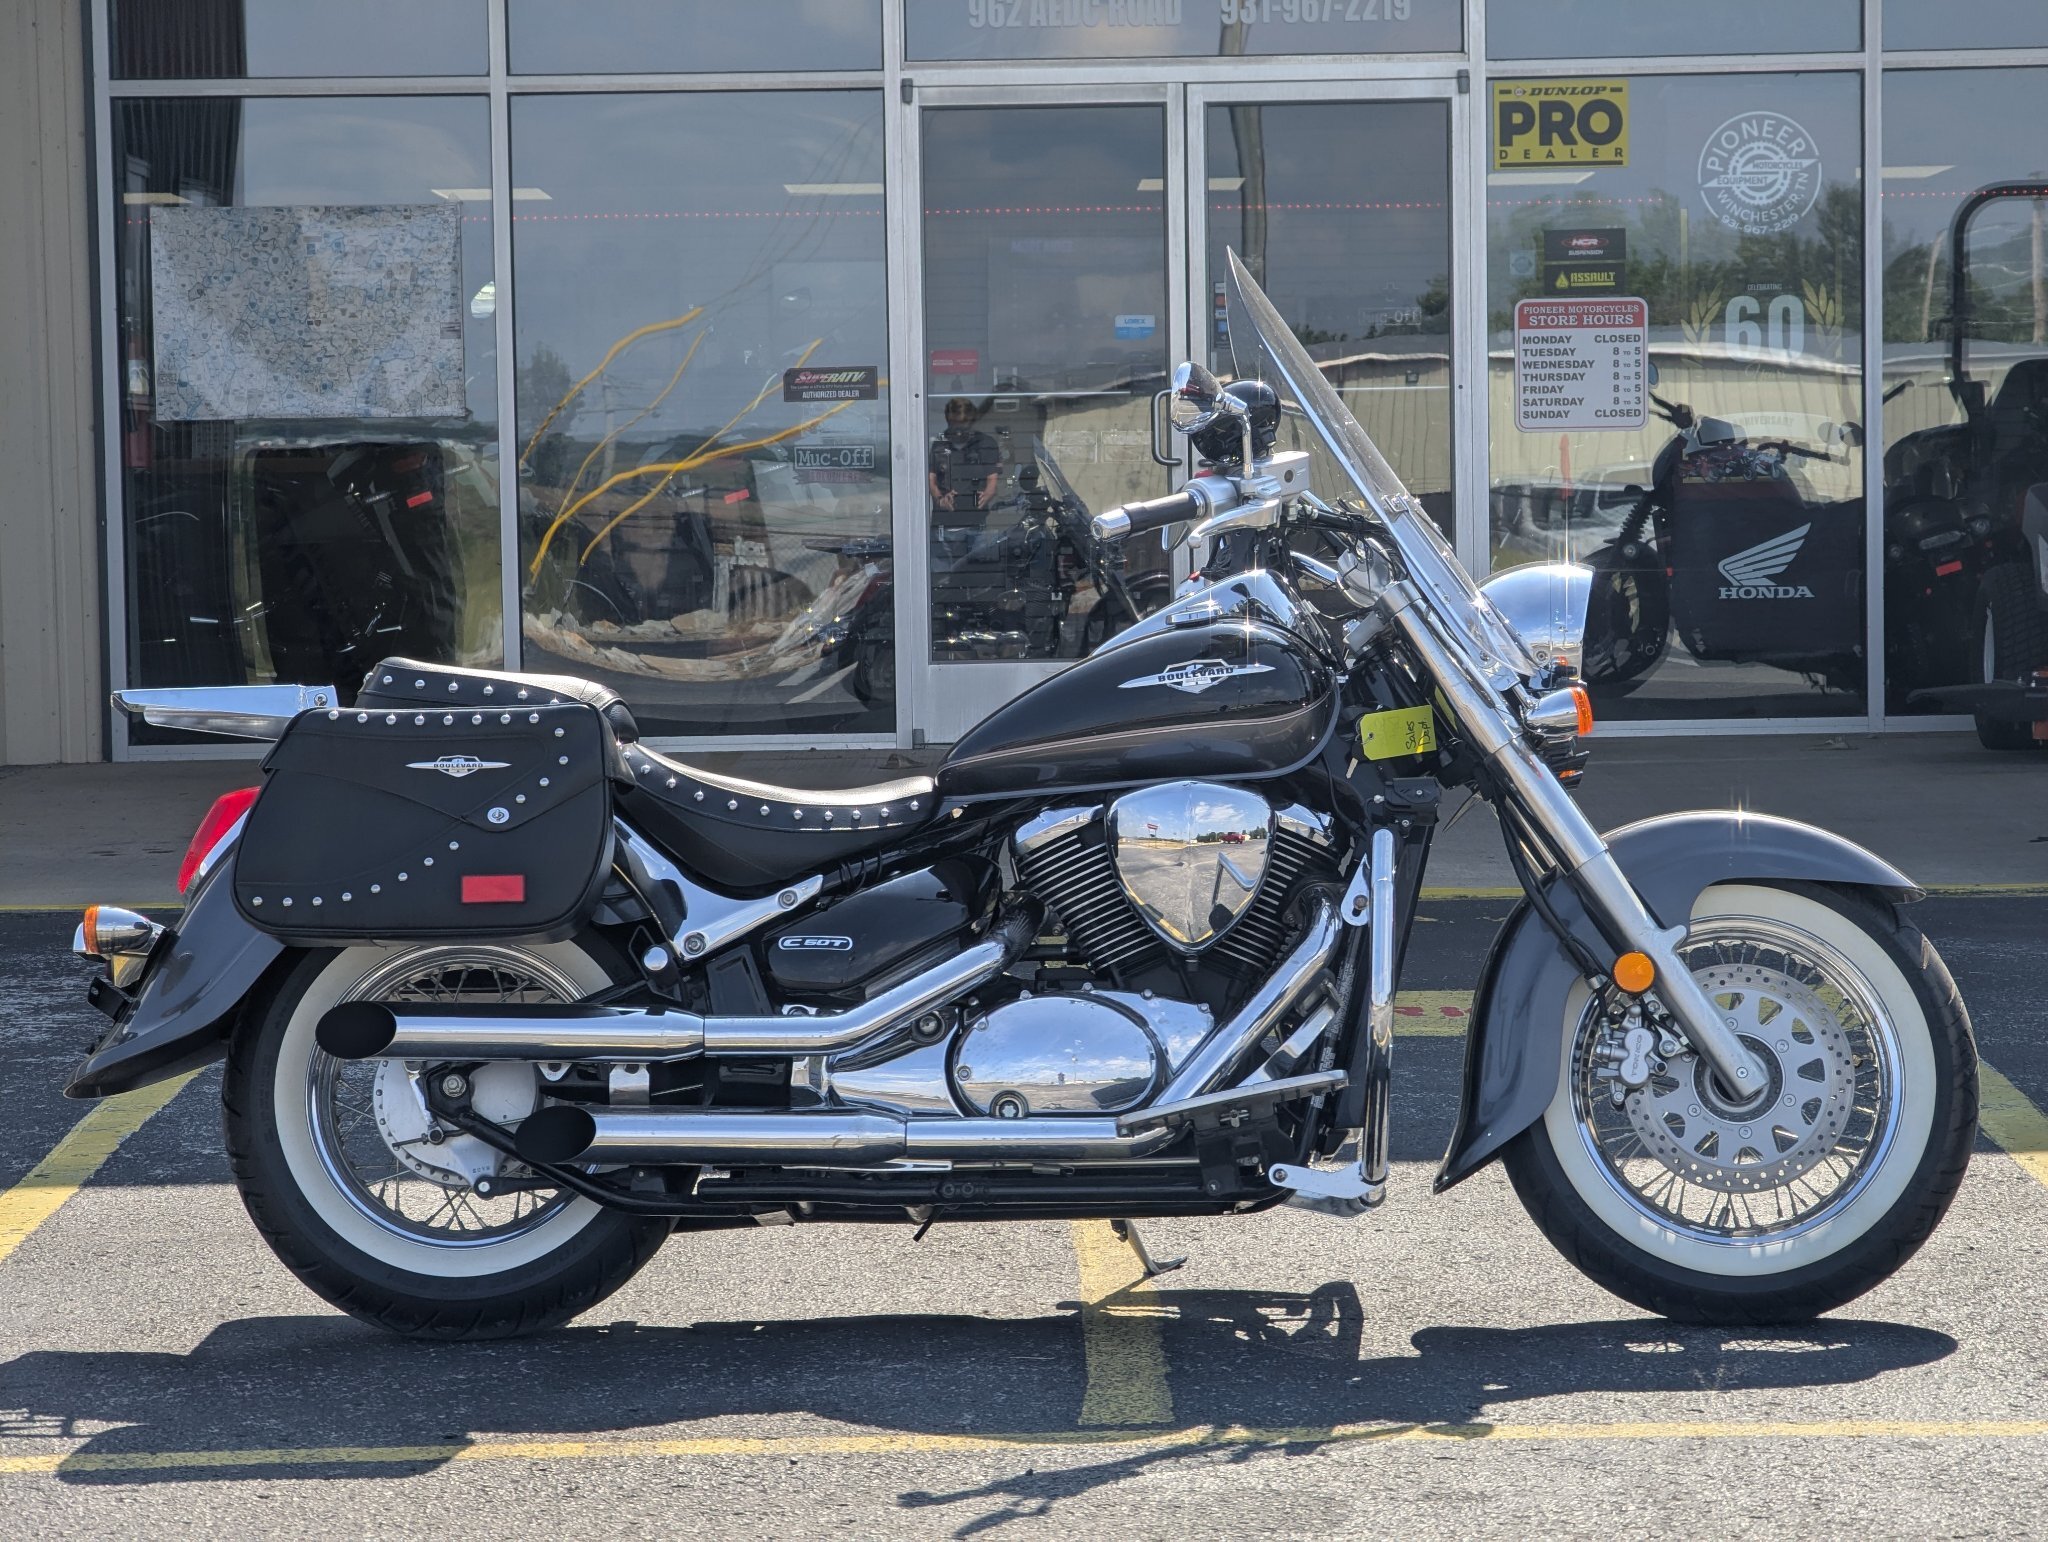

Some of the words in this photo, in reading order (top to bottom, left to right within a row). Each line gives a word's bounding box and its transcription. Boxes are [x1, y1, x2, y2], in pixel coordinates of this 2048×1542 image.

[968, 0, 1023, 28] 962
[1529, 86, 1607, 97] DUNLOP
[1499, 98, 1624, 147] PRO
[1706, 119, 1806, 172] PIONEER
[1499, 148, 1624, 160] DEALER
[1752, 161, 1803, 170] MOTORCYCLES
[1717, 176, 1769, 185] EQUIPMENT
[1795, 172, 1809, 192] TN
[1720, 212, 1799, 235] 931-967-2219
[1570, 271, 1616, 282] ASSAULT
[1747, 283, 1783, 291] CELEBRATING
[1523, 306, 1565, 315] PIONEER
[1568, 304, 1640, 314] MOTORCYCLES
[1529, 315, 1578, 326] STORE
[1583, 314, 1634, 325] HOURS
[1725, 294, 1805, 364] 60
[1522, 335, 1572, 345] MONDAY
[1594, 334, 1641, 344] CLOSED
[1522, 347, 1576, 357] TUESDAY
[1612, 347, 1620, 356] 8
[1634, 347, 1641, 356] 5
[1522, 360, 1595, 369] WEDNESDAY
[1612, 359, 1620, 368] 8
[1634, 359, 1641, 368] 5
[1522, 372, 1586, 382] THURSDAY
[1612, 372, 1620, 381] 8
[1634, 372, 1641, 381] 5
[838, 390, 860, 398] DEALER
[1522, 385, 1565, 394] FRIDAY
[1612, 384, 1620, 393] 8
[1634, 384, 1641, 393] 5
[1522, 397, 1585, 407] SATURDAY
[1612, 396, 1620, 405] 8
[1634, 396, 1641, 405] 3
[1522, 409, 1571, 419] SUNDAY
[1594, 408, 1641, 418] CLOSED
[797, 448, 871, 467] Muc-Off
[1718, 585, 1815, 600] HONDA
[1157, 666, 1234, 683] BOULEVARD
[1405, 720, 1417, 750] Sales
